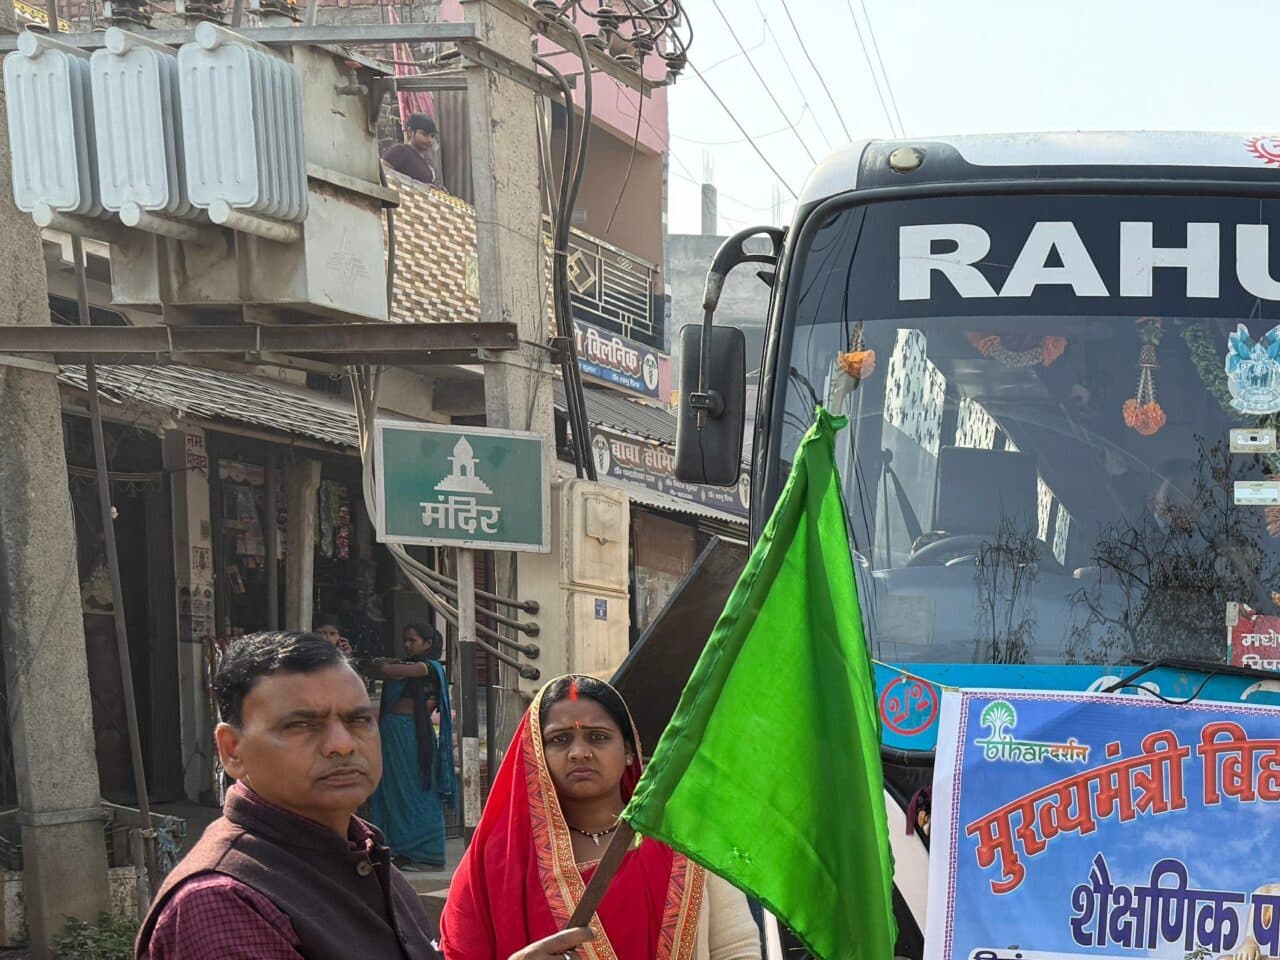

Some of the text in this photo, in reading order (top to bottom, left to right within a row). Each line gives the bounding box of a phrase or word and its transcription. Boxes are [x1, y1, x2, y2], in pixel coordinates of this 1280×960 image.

[419, 493, 502, 534] मंदिर
[966, 729, 1191, 895] मुख्यमंत्री
[1070, 852, 1246, 953] शैक्षणिक
